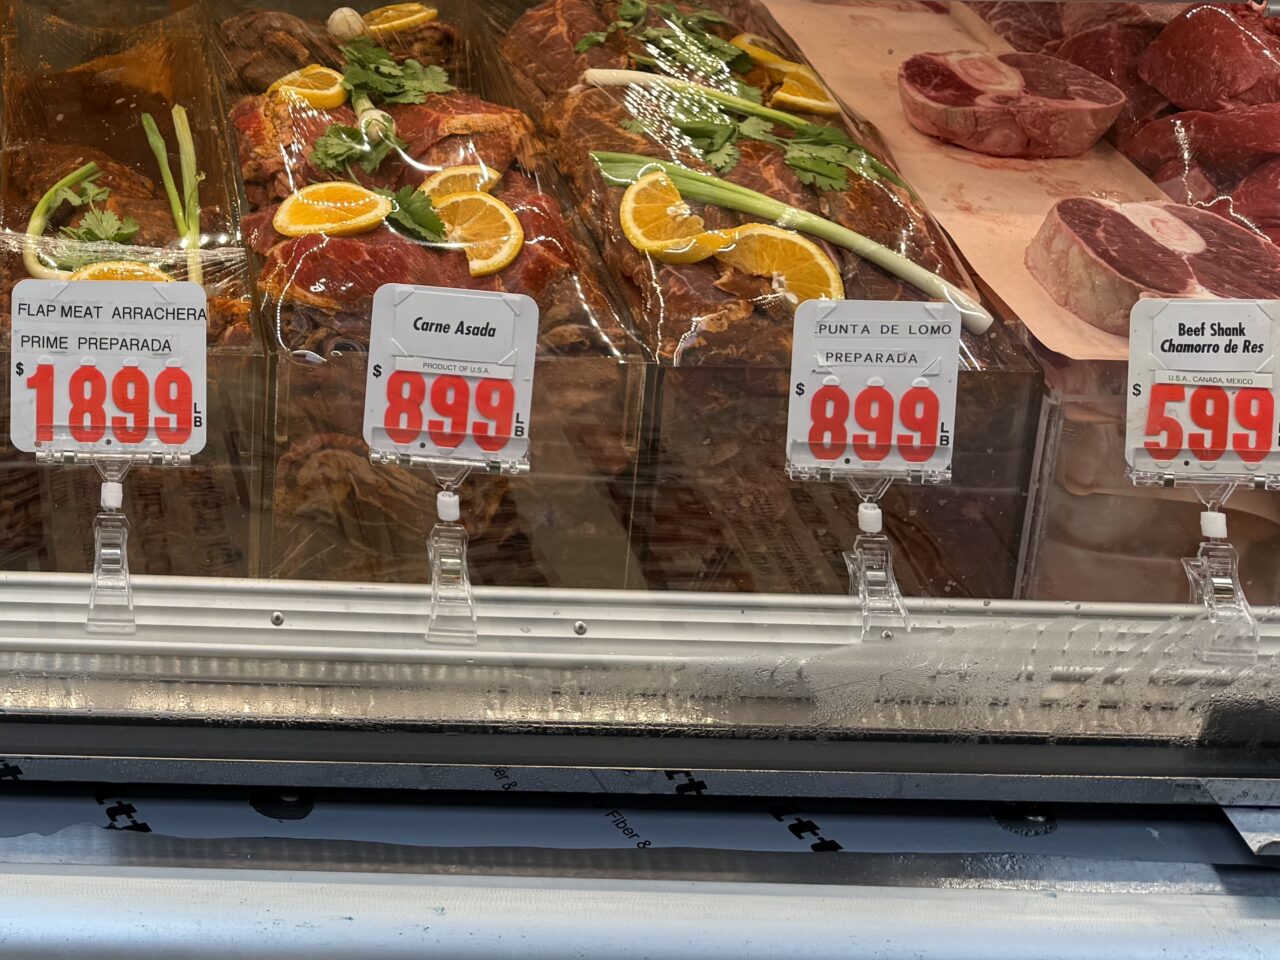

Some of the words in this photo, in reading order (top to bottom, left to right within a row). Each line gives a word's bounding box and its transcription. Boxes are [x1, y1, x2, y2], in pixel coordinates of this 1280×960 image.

[18, 304, 56, 317] FLAP
[61, 305, 103, 318] MEAT
[111, 307, 207, 321] ARRACHERA
[413, 317, 451, 333] Carne
[455, 321, 496, 337] Asada
[818, 324, 871, 334] PUNTA
[880, 325, 899, 334] DE
[909, 324, 952, 335] LOMO
[1178, 322, 1205, 337] Beef
[1210, 322, 1246, 337] Shank
[20, 335, 69, 349] PRIME
[78, 337, 172, 352] PREPARADA
[1160, 339, 1219, 353] Chamorro
[1224, 340, 1238, 353] de
[1242, 340, 1264, 354] Res
[826, 352, 918, 364] PREPARADA
[422, 362, 457, 371] PRODUCT
[1192, 376, 1225, 384] CANADA,
[604, 809, 641, 840] Fiber
